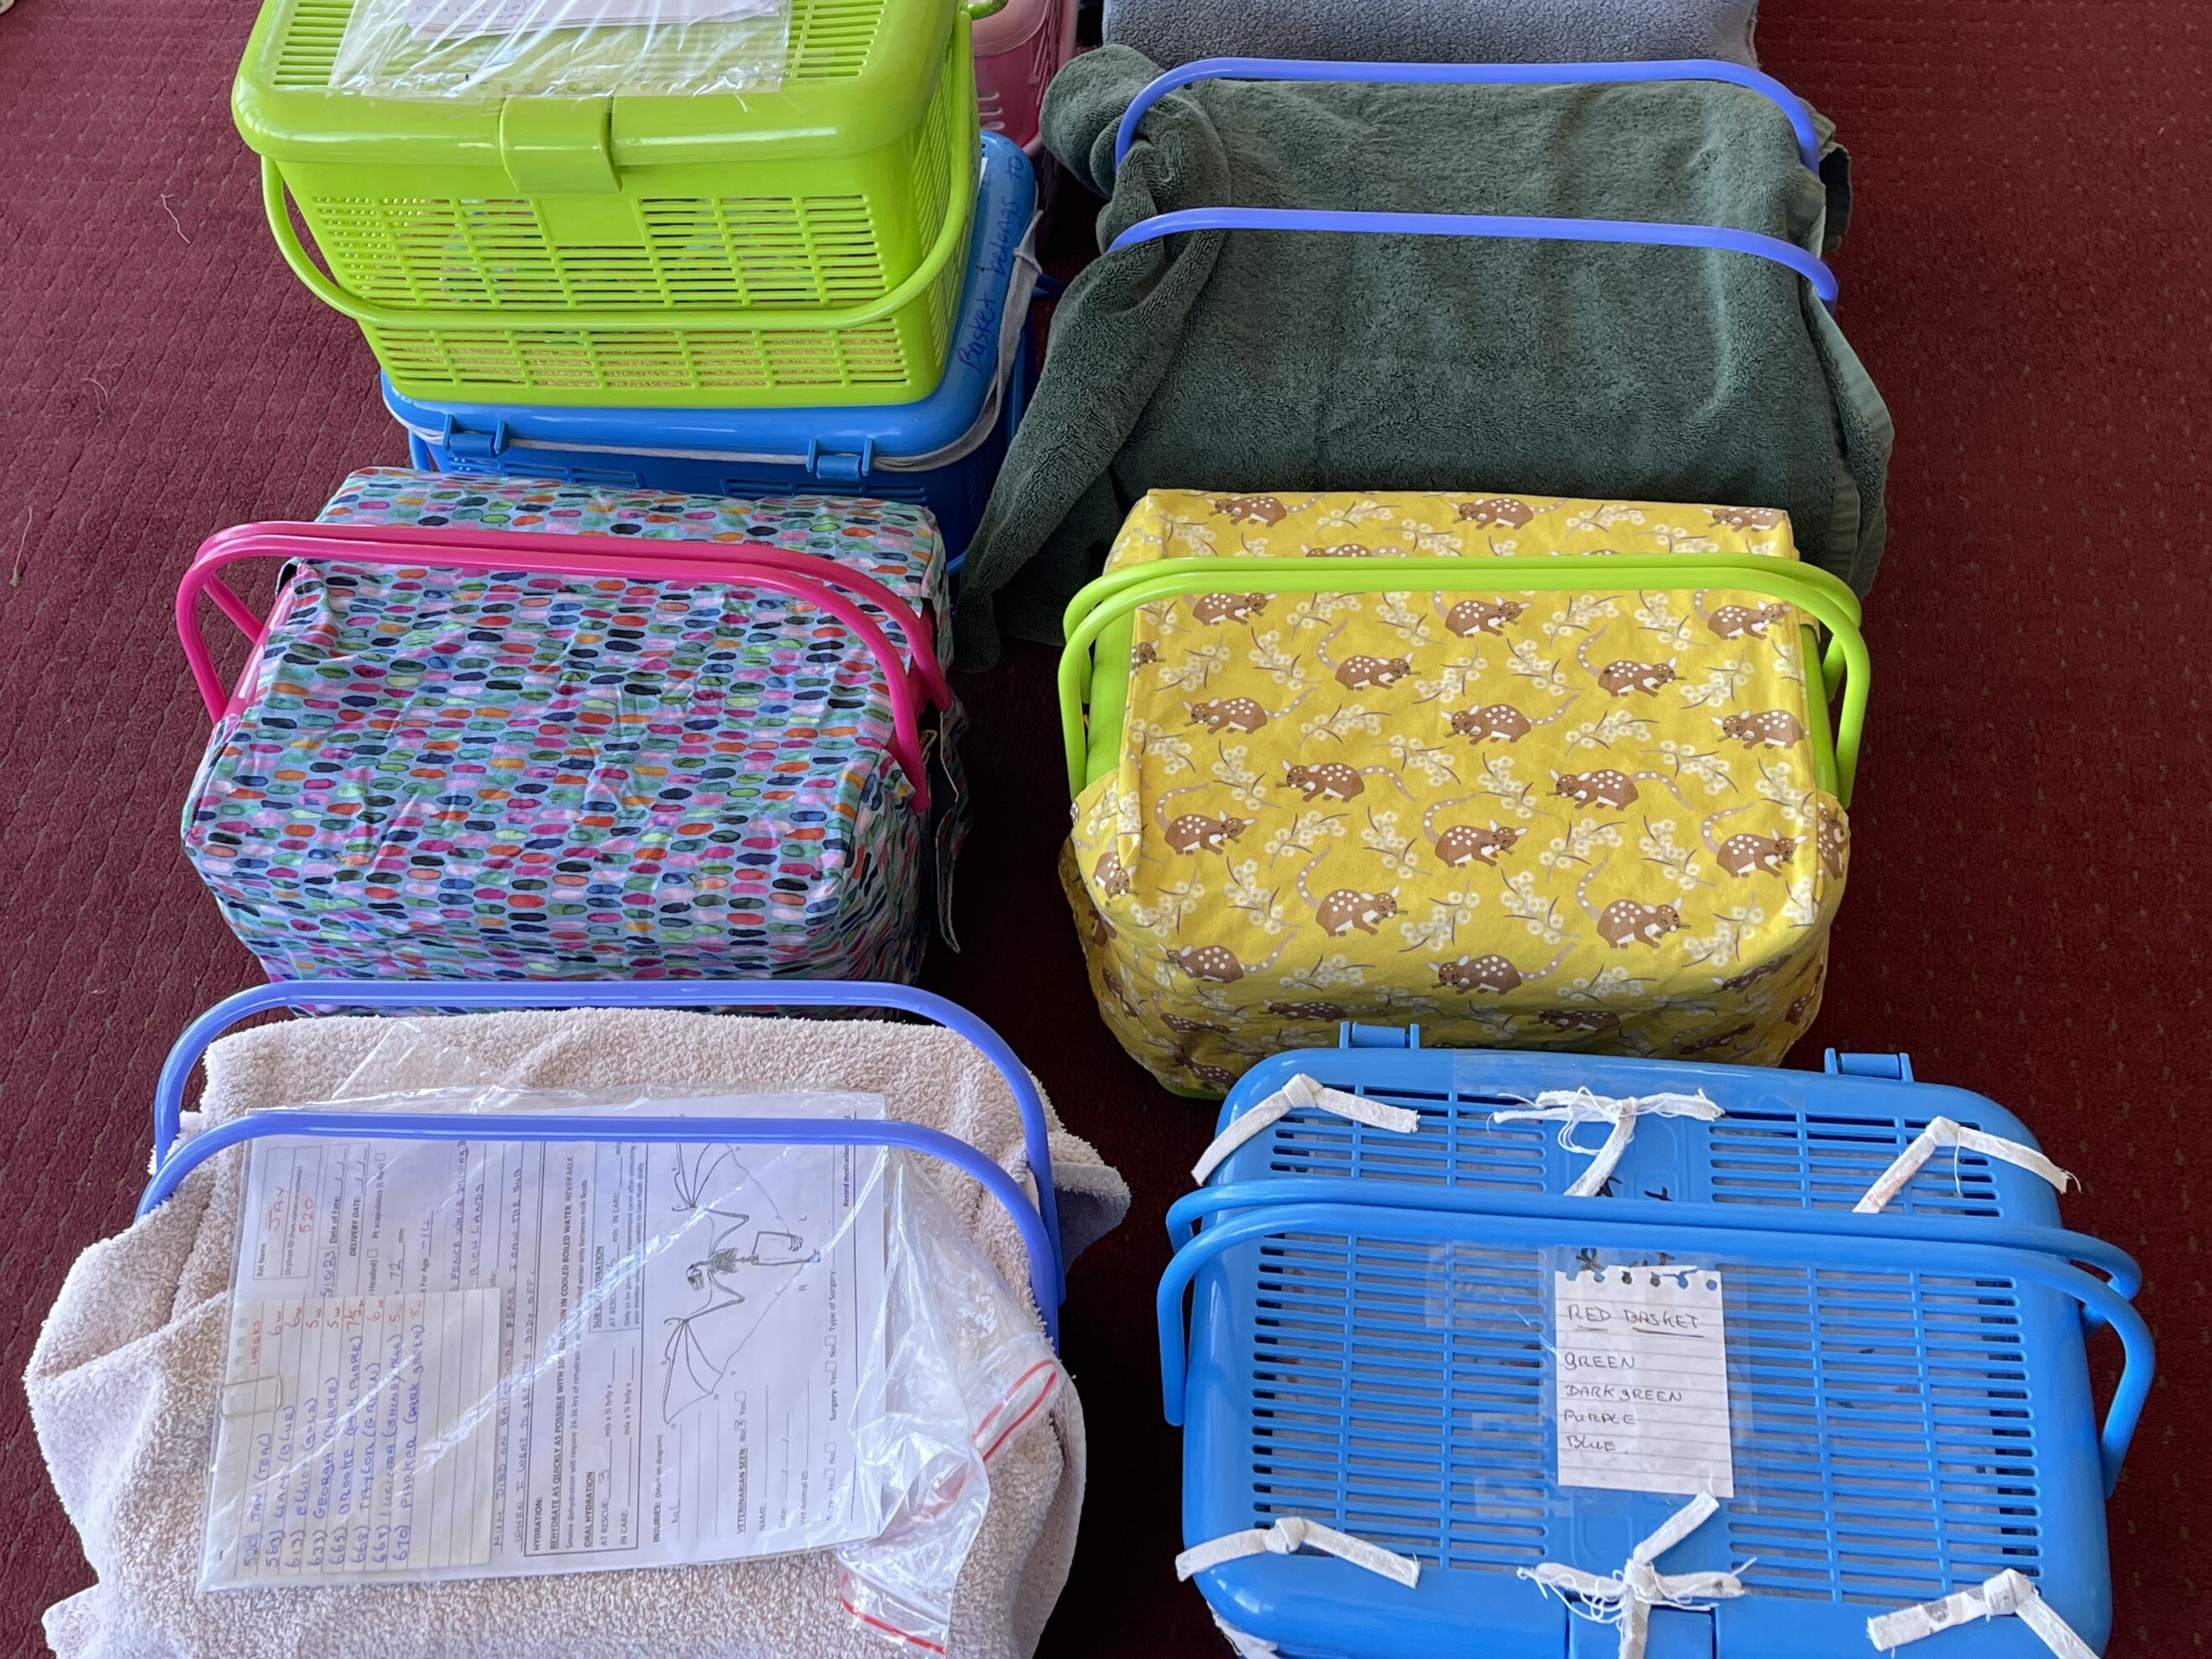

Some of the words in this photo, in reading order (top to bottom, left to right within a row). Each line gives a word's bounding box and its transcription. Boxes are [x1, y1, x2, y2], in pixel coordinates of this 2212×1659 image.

[958, 291, 996, 375] Basket
[983, 197, 1023, 275] belongs
[1006, 155, 1023, 181] to
[269, 1186, 288, 1231] JAY
[299, 1197, 313, 1232] 520
[331, 1216, 337, 1224] of
[612, 1214, 620, 1223] IN
[329, 1226, 337, 1243] Date
[349, 1220, 359, 1256] DELIVERY
[398, 1228, 405, 1243] mm
[562, 1235, 571, 1263] BOILED
[285, 1250, 294, 1275] Orphan
[369, 1259, 378, 1291] Headed)
[421, 1258, 430, 1273] Age
[561, 1264, 569, 1296] COOLED
[561, 1298, 567, 1306] IN
[829, 1301, 835, 1310] of
[609, 1316, 616, 1327] AT
[829, 1312, 838, 1332] Type
[1567, 1306, 1611, 1322] RED
[1623, 1310, 1699, 1329] BASKET
[829, 1345, 836, 1357] No
[556, 1372, 564, 1393] WITH
[1565, 1384, 1615, 1400] DARK
[343, 1396, 358, 1436] (DAK
[555, 1395, 563, 1432] POSSIBLE
[277, 1405, 294, 1462] (BLUE)
[554, 1436, 562, 1446] AS
[739, 1430, 746, 1441] No
[552, 1447, 562, 1484] QUICKLY
[829, 1452, 835, 1464] No
[359, 1442, 374, 1511] TAYLOR
[274, 1474, 289, 1517] LIAM
[552, 1486, 559, 1497] AS
[567, 1475, 578, 1521] dehydration
[584, 1471, 594, 1522] HYDRATION
[737, 1471, 746, 1534] VETERINARIAN
[533, 1498, 542, 1551] HYDRATION:
[550, 1499, 559, 1550] REHYDRATE
[601, 1498, 609, 1533] RESCUE:
[653, 1502, 662, 1542] INJURIES:
[566, 1523, 574, 1549] Severe
[584, 1525, 593, 1547] ORAL
[601, 1536, 608, 1546] AT
[620, 1536, 627, 1545] IN
